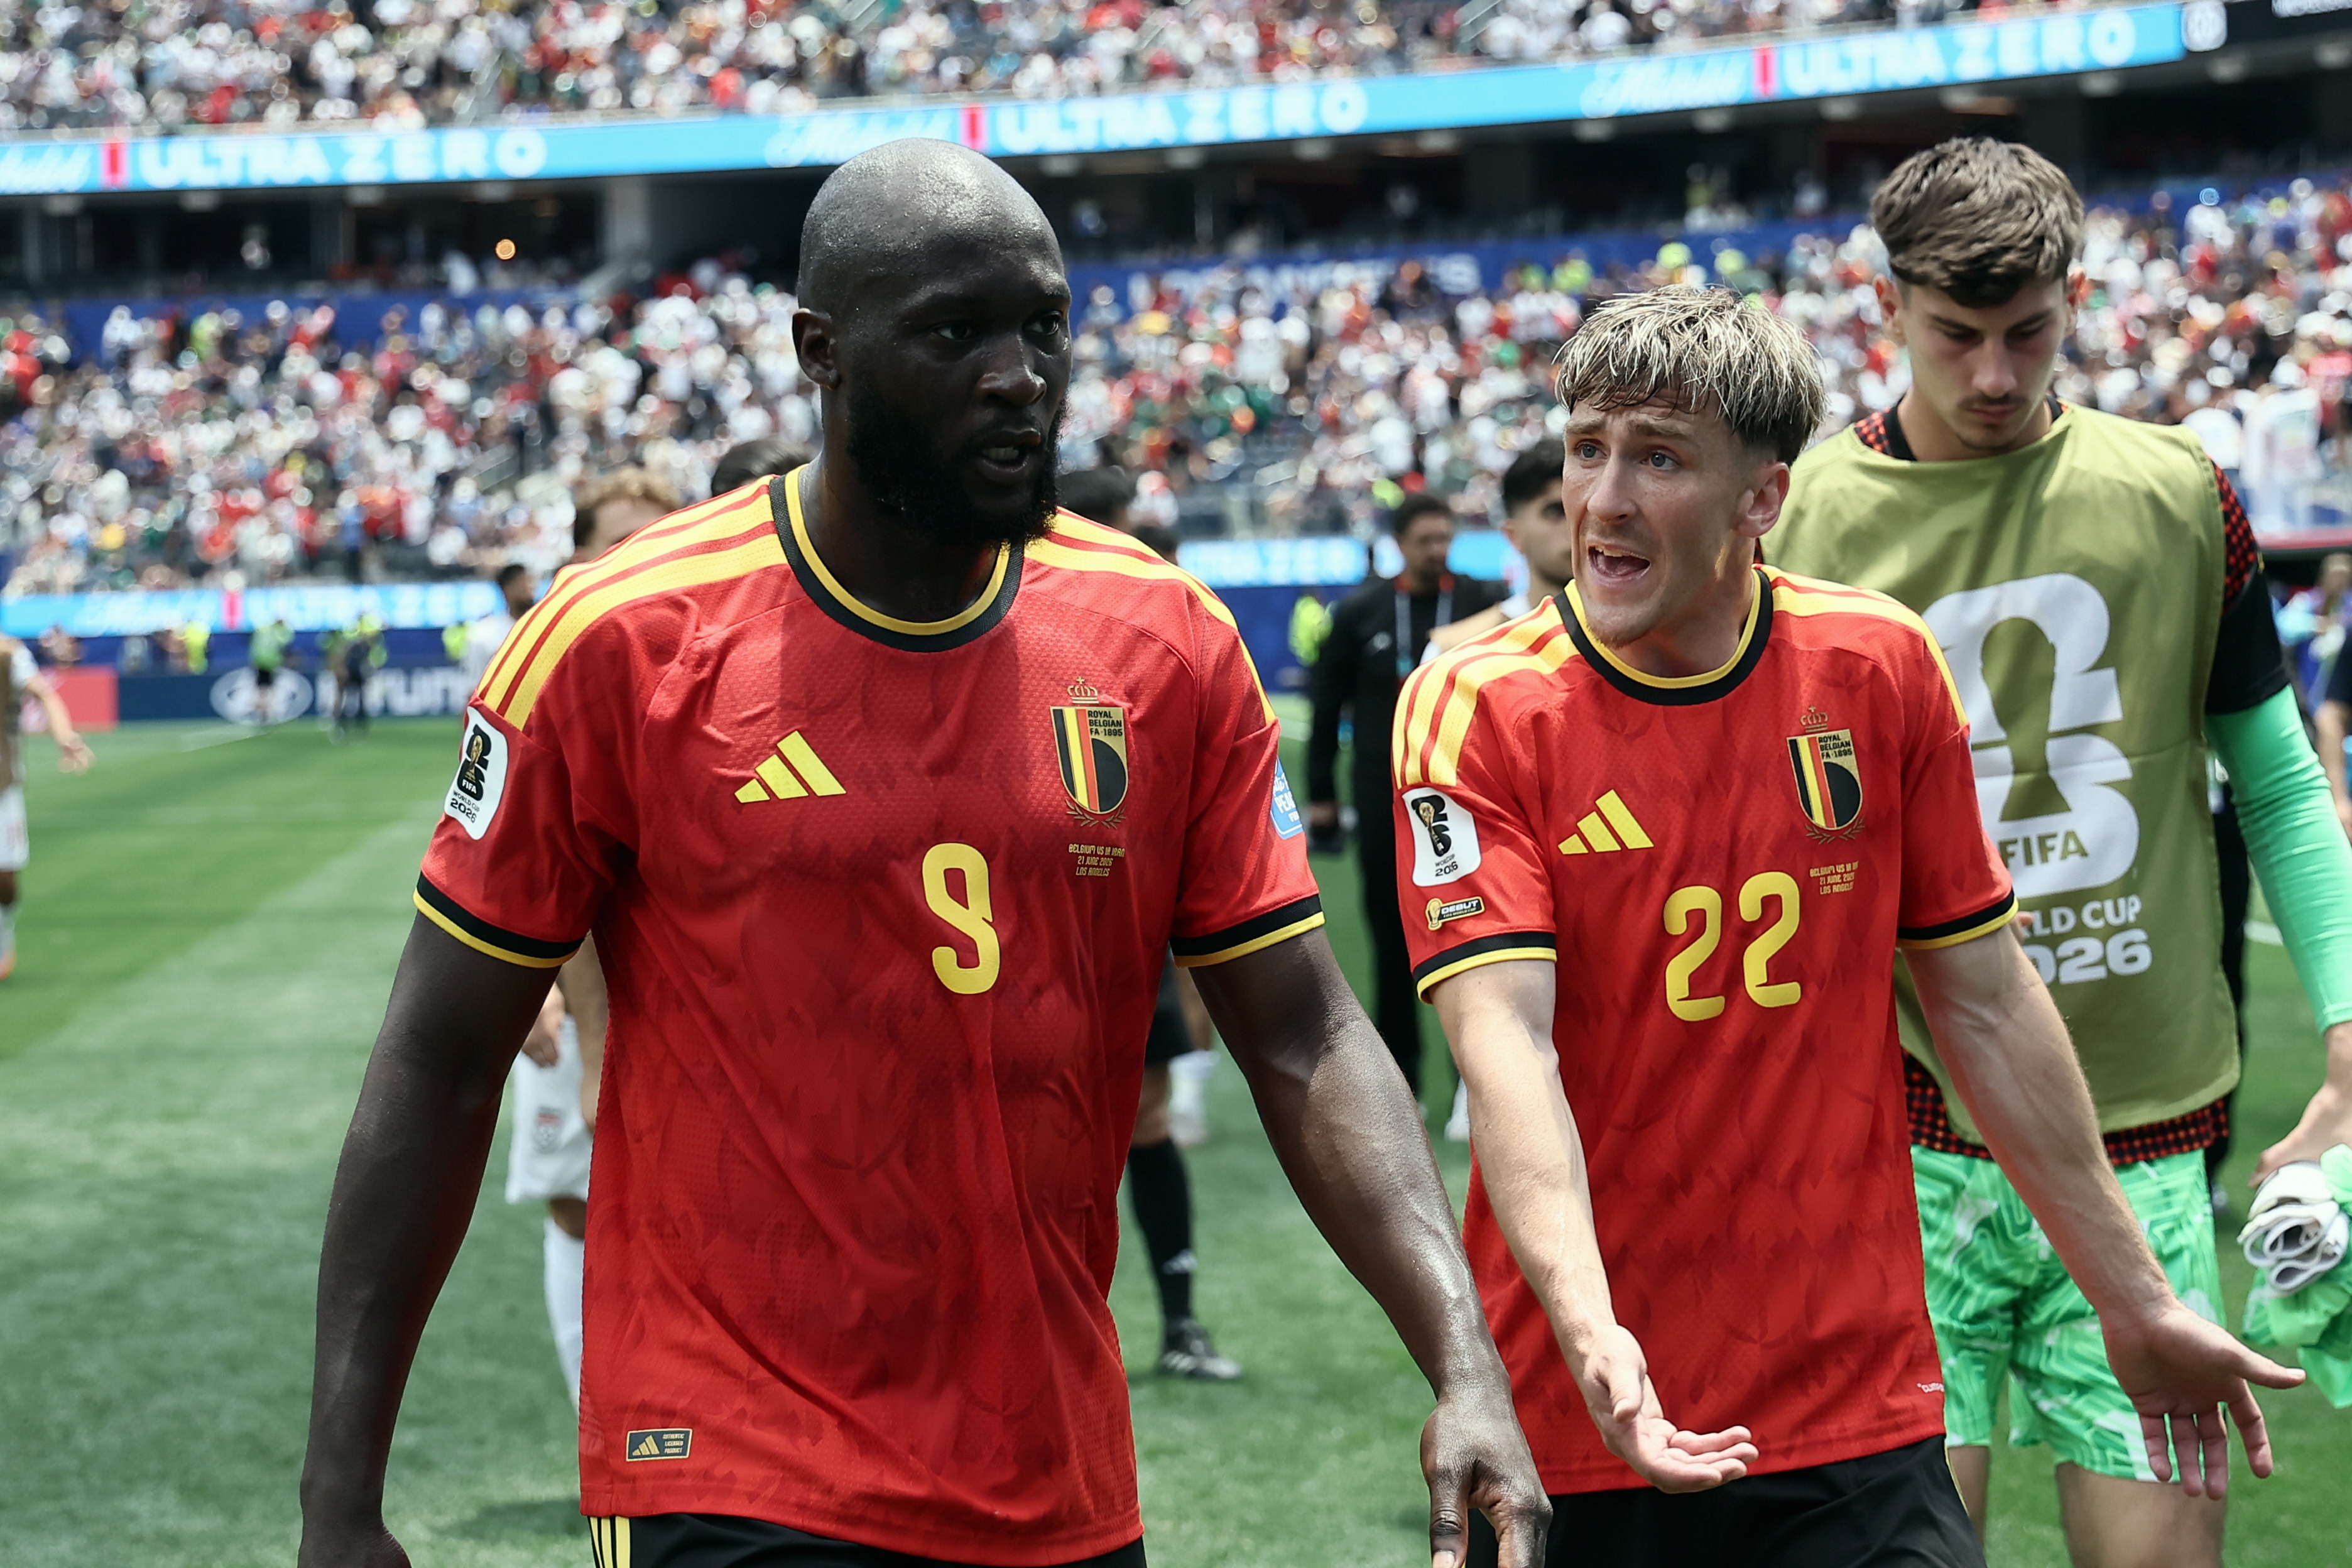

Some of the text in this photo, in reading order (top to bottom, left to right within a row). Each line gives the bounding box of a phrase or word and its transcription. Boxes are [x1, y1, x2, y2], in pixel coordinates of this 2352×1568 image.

[1783, 29, 1946, 96] ULTRA
[1952, 9, 2136, 80] ZERO
[996, 97, 1178, 154] ULTRA
[1182, 82, 1369, 142] ZERO
[139, 136, 332, 188] ULTRA
[341, 128, 548, 182] ZERO
[1089, 719, 1122, 727] BELGIAN
[1818, 734, 1841, 743] ROYAL
[1820, 740, 1851, 751] BELGIAN
[462, 779, 477, 794] FIFA
[453, 790, 471, 805] WORLD
[450, 798, 477, 824] 2026
[1069, 844, 1096, 854] BELGIUM
[1111, 847, 1125, 857] IRAN
[1999, 830, 2089, 869] FIFA
[1077, 856, 1114, 866] 21 JUNE 2026
[1075, 867, 1110, 876] LOS ANGELES
[1809, 866, 1835, 877] BELGIUM
[1820, 885, 1831, 895] LOS
[1441, 900, 1479, 915] DEBUT
[2081, 894, 2142, 929] CUP
[922, 842, 1001, 995] 9
[1663, 871, 1801, 1021] 22
[2022, 928, 2153, 985] 026
